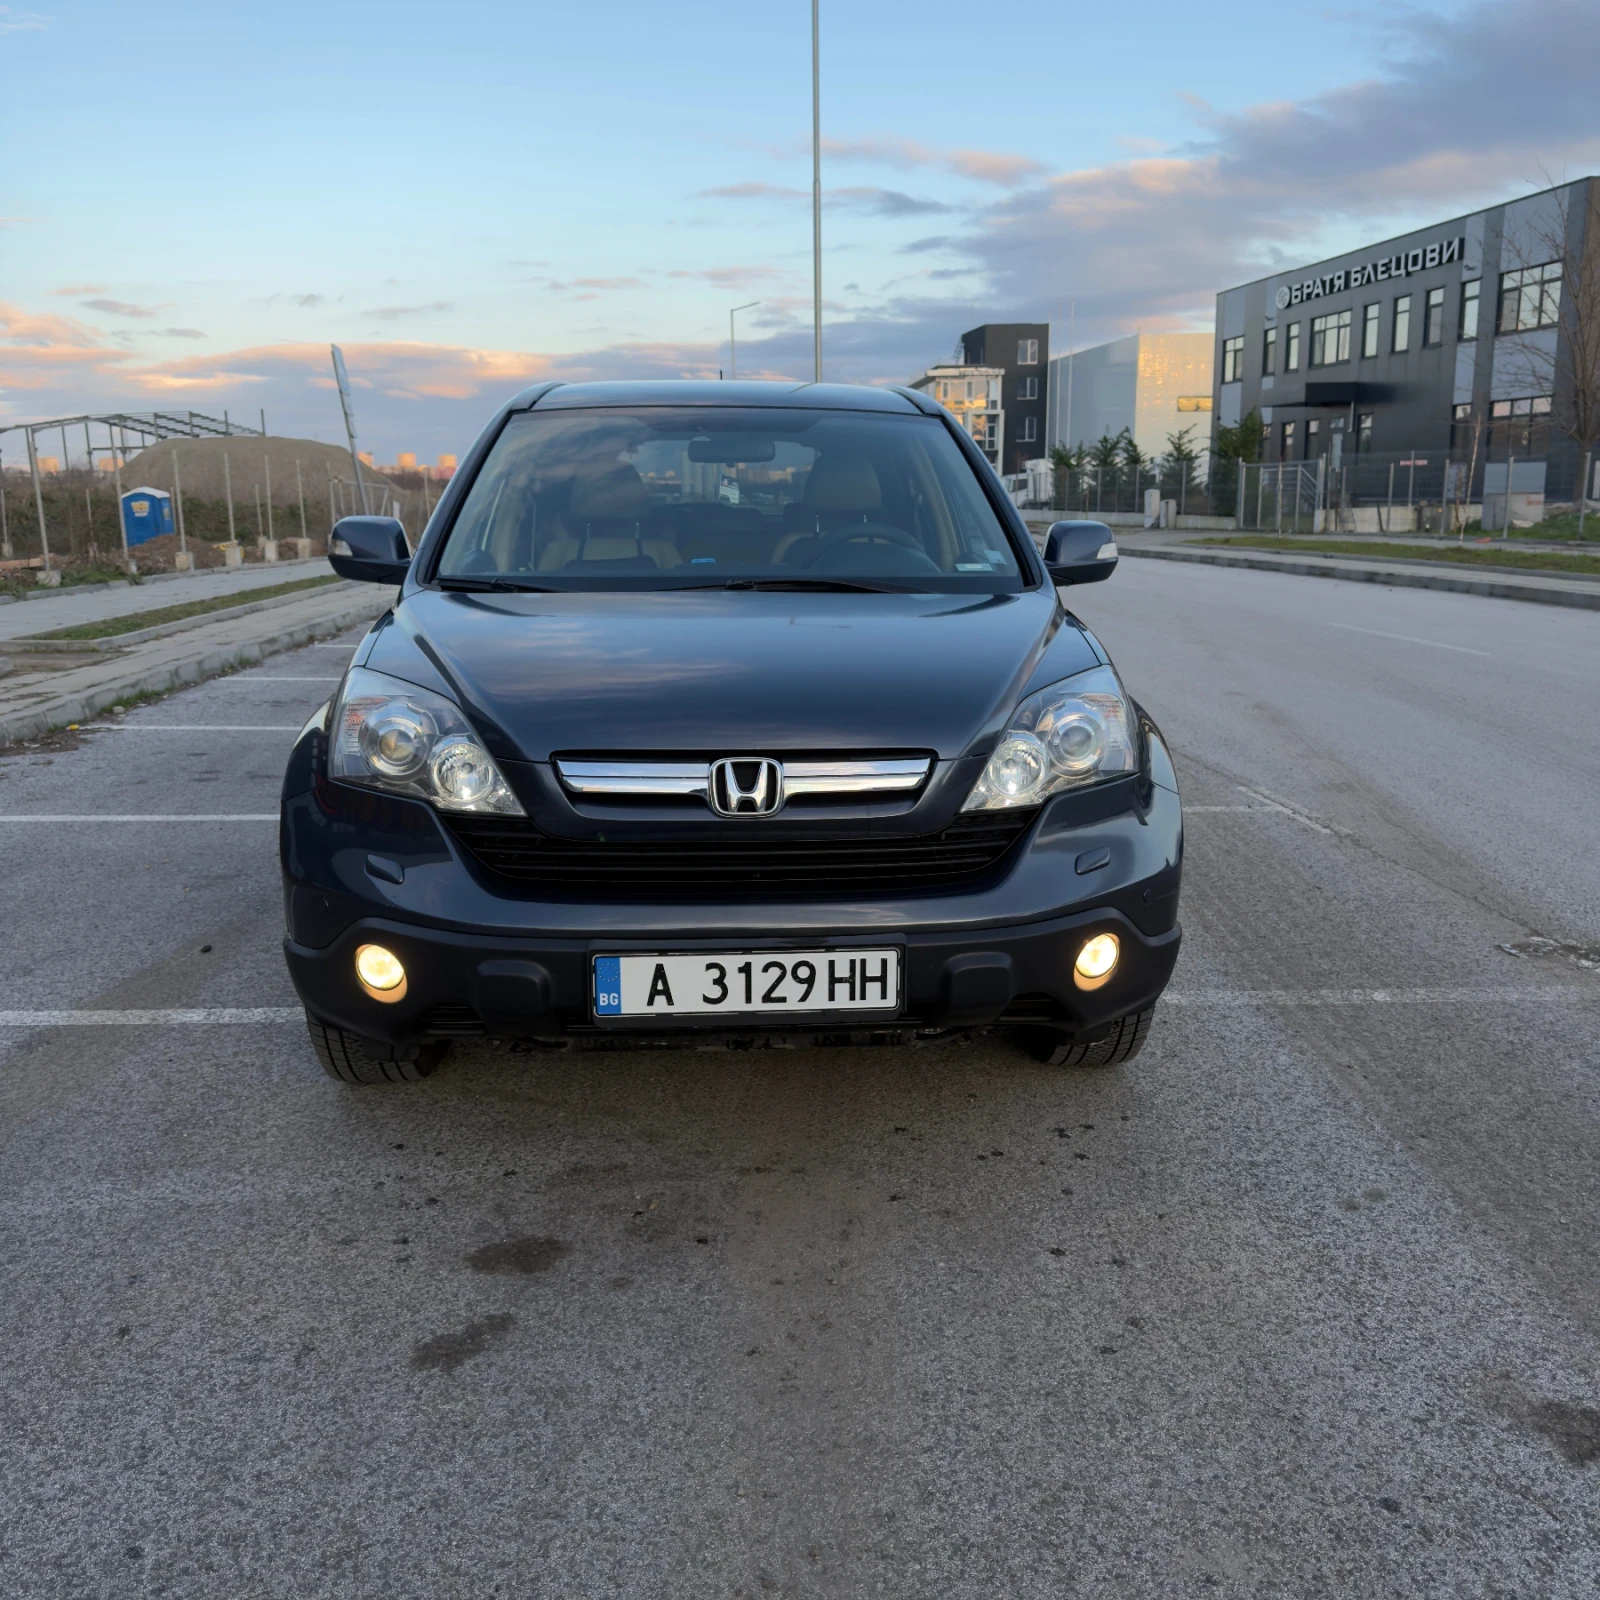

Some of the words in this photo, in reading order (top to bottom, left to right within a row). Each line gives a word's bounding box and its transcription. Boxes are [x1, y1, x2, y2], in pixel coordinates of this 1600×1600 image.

[1291, 270, 1345, 305] БРАТЯ
[1351, 237, 1460, 288] БЛЕЦОВИ
[599, 993, 619, 1006] BG
[646, 963, 675, 1007] A
[702, 957, 888, 1005] 3129HH
